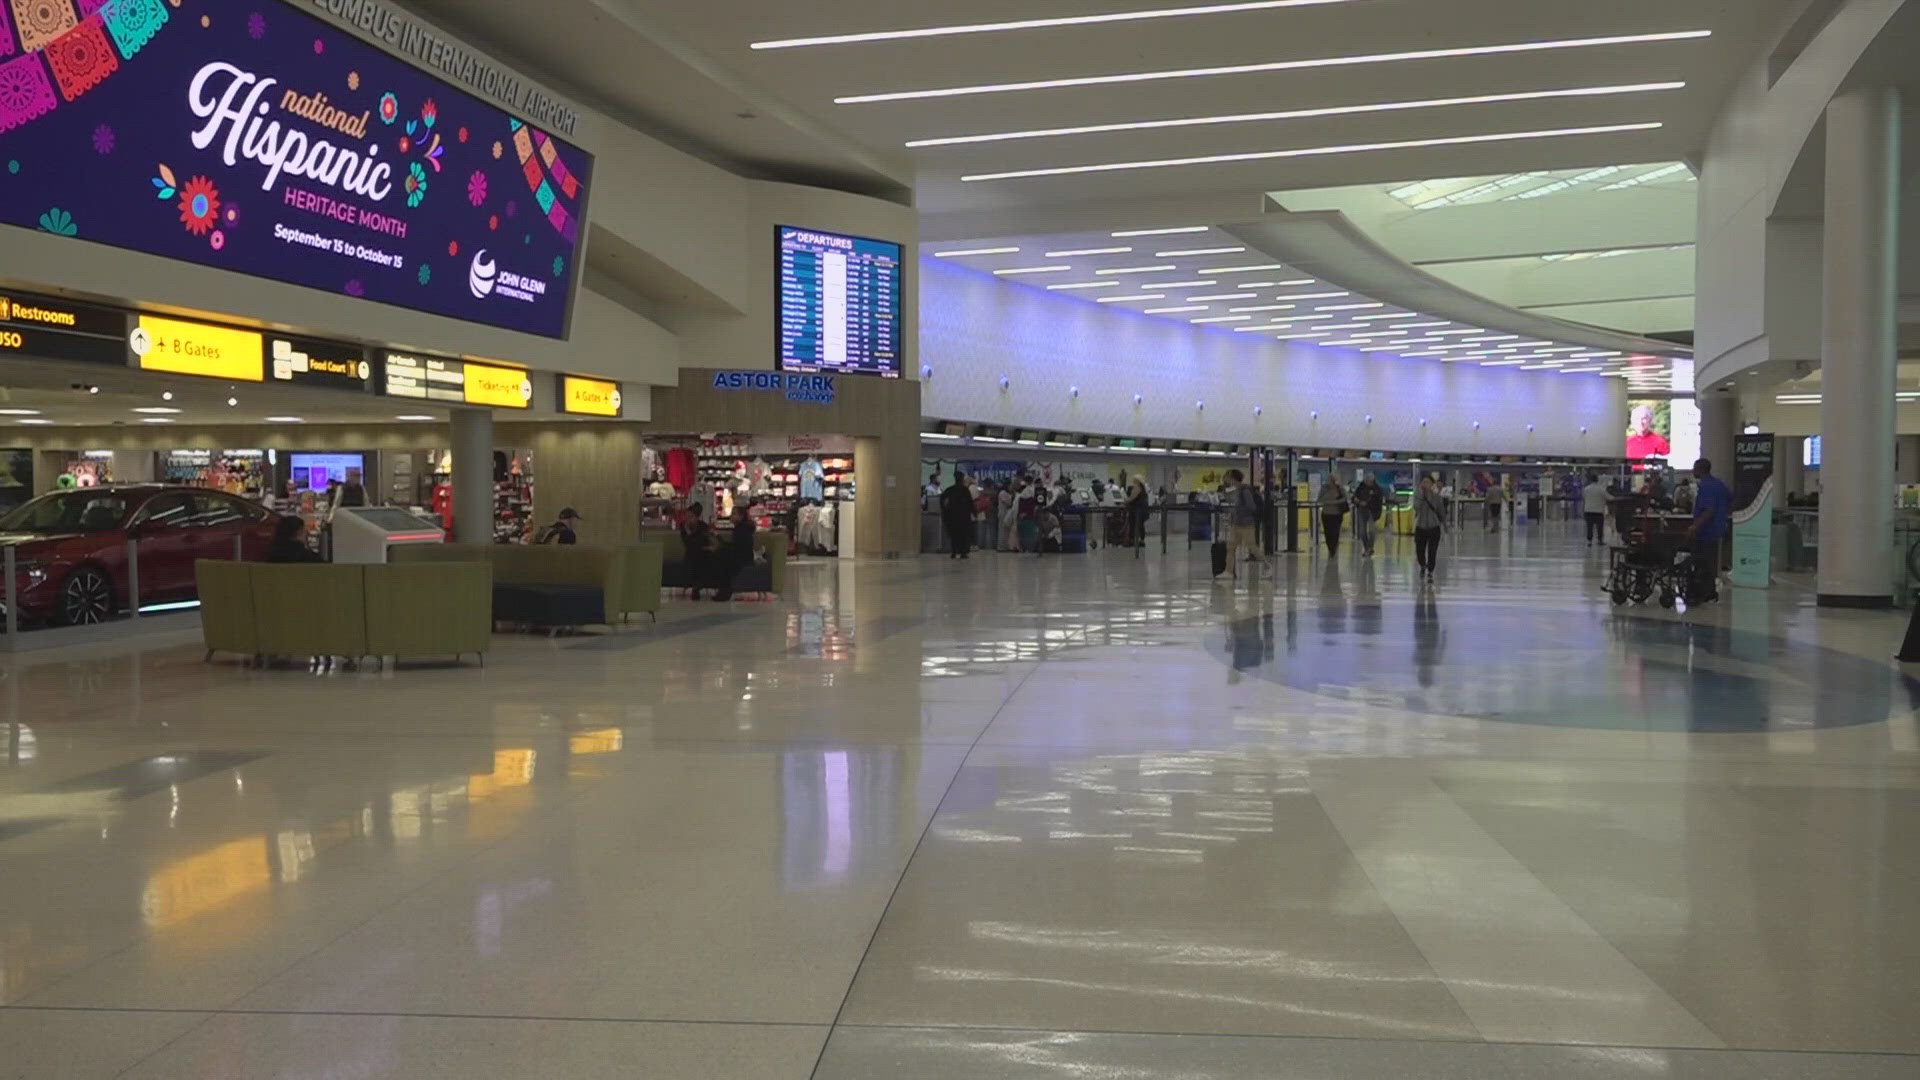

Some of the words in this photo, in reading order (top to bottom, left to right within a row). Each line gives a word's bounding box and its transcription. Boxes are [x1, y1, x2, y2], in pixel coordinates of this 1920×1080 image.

[400, 22, 521, 107] INTERNATIONAL
[523, 87, 580, 136] AIRPORT
[280, 88, 371, 140] national
[188, 62, 392, 201] Hispanic
[284, 187, 357, 224] HERITAGE
[359, 209, 407, 239] MONTH
[274, 223, 332, 250] September
[333, 239, 344, 254] 15
[344, 241, 355, 257] to
[356, 244, 393, 267] October
[393, 255, 404, 269] 15
[797, 232, 852, 250] DEPARTURES
[495, 285, 535, 302] INTERNATIONAL
[496, 270, 520, 288] JOHN
[520, 276, 546, 295] GLENN
[11, 303, 76, 326] Restrooms
[173, 339, 181, 354] B
[185, 340, 221, 360] Gates
[309, 358, 327, 371] Food
[327, 360, 347, 373] Court
[714, 372, 781, 388] ASTOR
[785, 374, 834, 391] PARK
[575, 390, 581, 400] A
[582, 391, 601, 402] Gates
[1736, 442, 1756, 453] PLAY
